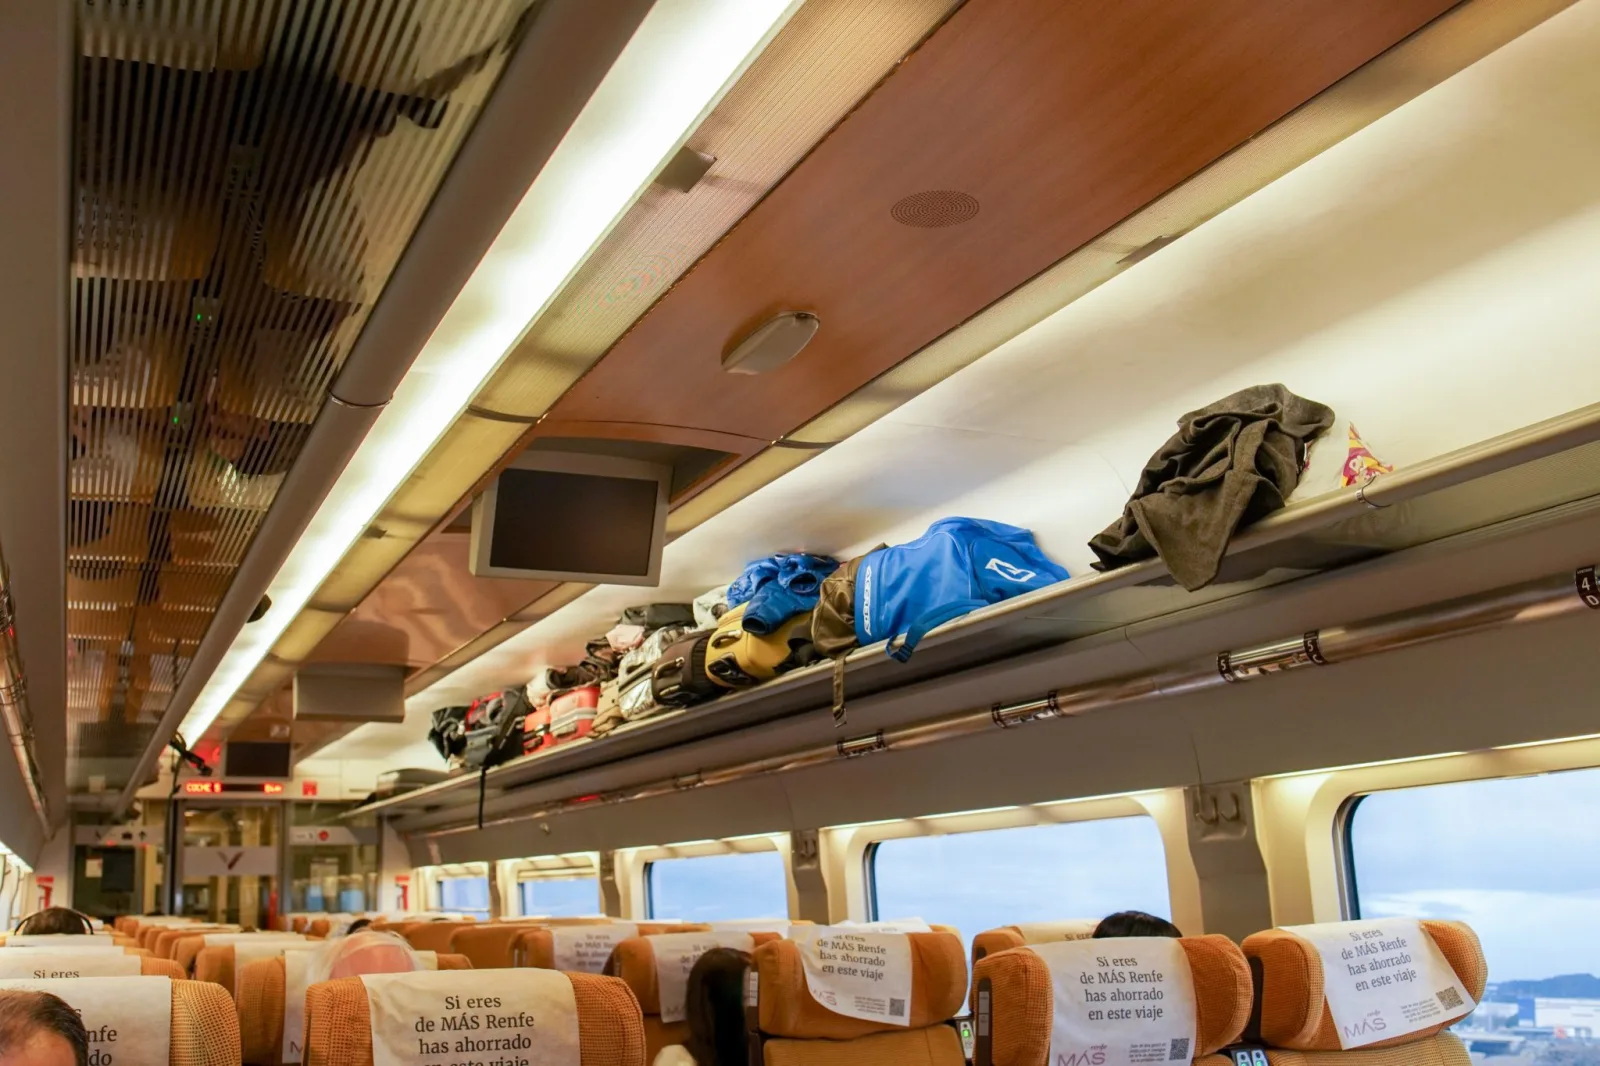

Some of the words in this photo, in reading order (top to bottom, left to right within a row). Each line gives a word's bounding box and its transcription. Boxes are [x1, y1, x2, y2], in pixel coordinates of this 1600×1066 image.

[1582, 577, 1590, 590] 4
[1586, 595, 1599, 605] D
[1307, 640, 1314, 652] 5
[1220, 660, 1227, 671] 5
[1349, 931, 1361, 942] Si
[1363, 929, 1384, 940] eres
[817, 938, 828, 947] de
[857, 943, 887, 954] Renfe
[1342, 947, 1354, 960] de
[1355, 940, 1379, 958] MÁS
[1380, 937, 1408, 952] Renfe
[820, 950, 837, 960] has
[841, 953, 886, 966] ahorrado
[1096, 956, 1109, 967] Si
[1112, 957, 1138, 967] eres
[1347, 963, 1367, 976] has
[1370, 952, 1412, 972] ahorrado
[33, 970, 46, 979] Si
[51, 970, 80, 979] eres
[822, 965, 834, 973] en
[837, 966, 858, 976] este
[860, 968, 884, 982] viaje
[1080, 971, 1094, 984] de
[1098, 969, 1126, 984] MÁS
[1129, 970, 1164, 983] Renfe
[1355, 980, 1369, 991] en
[1371, 975, 1392, 988] este
[1393, 969, 1418, 983] viaje
[1085, 989, 1107, 1002] has
[1110, 987, 1164, 1001] ahorrado
[445, 995, 461, 1010] Si
[466, 997, 502, 1009] eres
[1088, 1010, 1103, 1020] en
[1107, 1008, 1132, 1019] este
[1135, 1006, 1163, 1021] viaje
[415, 1016, 435, 1033] de
[441, 1012, 480, 1031] MÁS
[486, 1012, 535, 1029] Renfe
[86, 1025, 118, 1043] nfe
[419, 1039, 449, 1055] has
[455, 1034, 532, 1053] ahorrado
